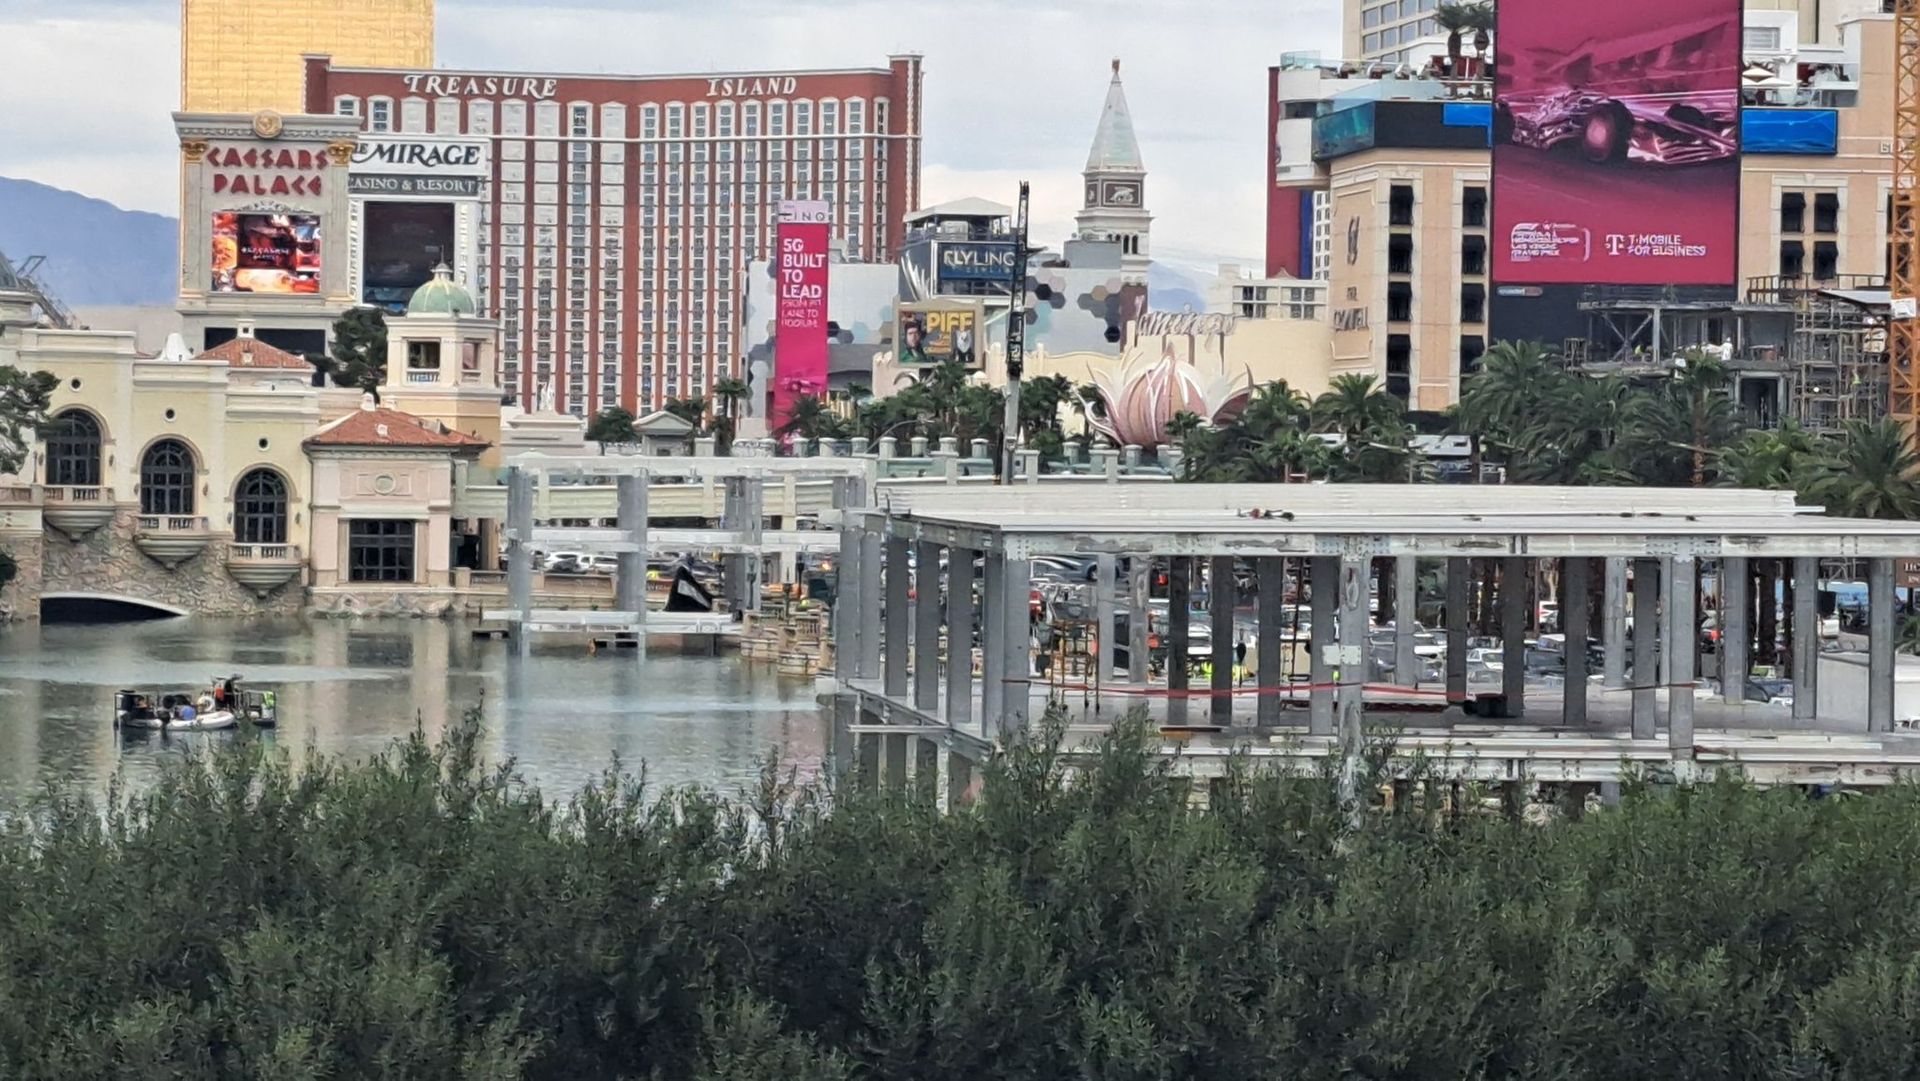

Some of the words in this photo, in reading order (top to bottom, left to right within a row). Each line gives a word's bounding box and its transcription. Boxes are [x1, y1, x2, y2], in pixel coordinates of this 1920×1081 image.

[403, 75, 558, 99] TREASURE
[706, 76, 797, 97] ISLAND
[207, 147, 329, 170] CAESARS
[351, 143, 481, 167] MIRAGE
[214, 173, 321, 196] PALACE
[401, 180, 413, 191] &
[416, 180, 476, 193] RESORT
[783, 238, 804, 253] 5G
[783, 254, 826, 268] BUILT
[782, 269, 803, 283] TO
[782, 284, 822, 298] LEAD
[927, 311, 975, 334] PIFF
